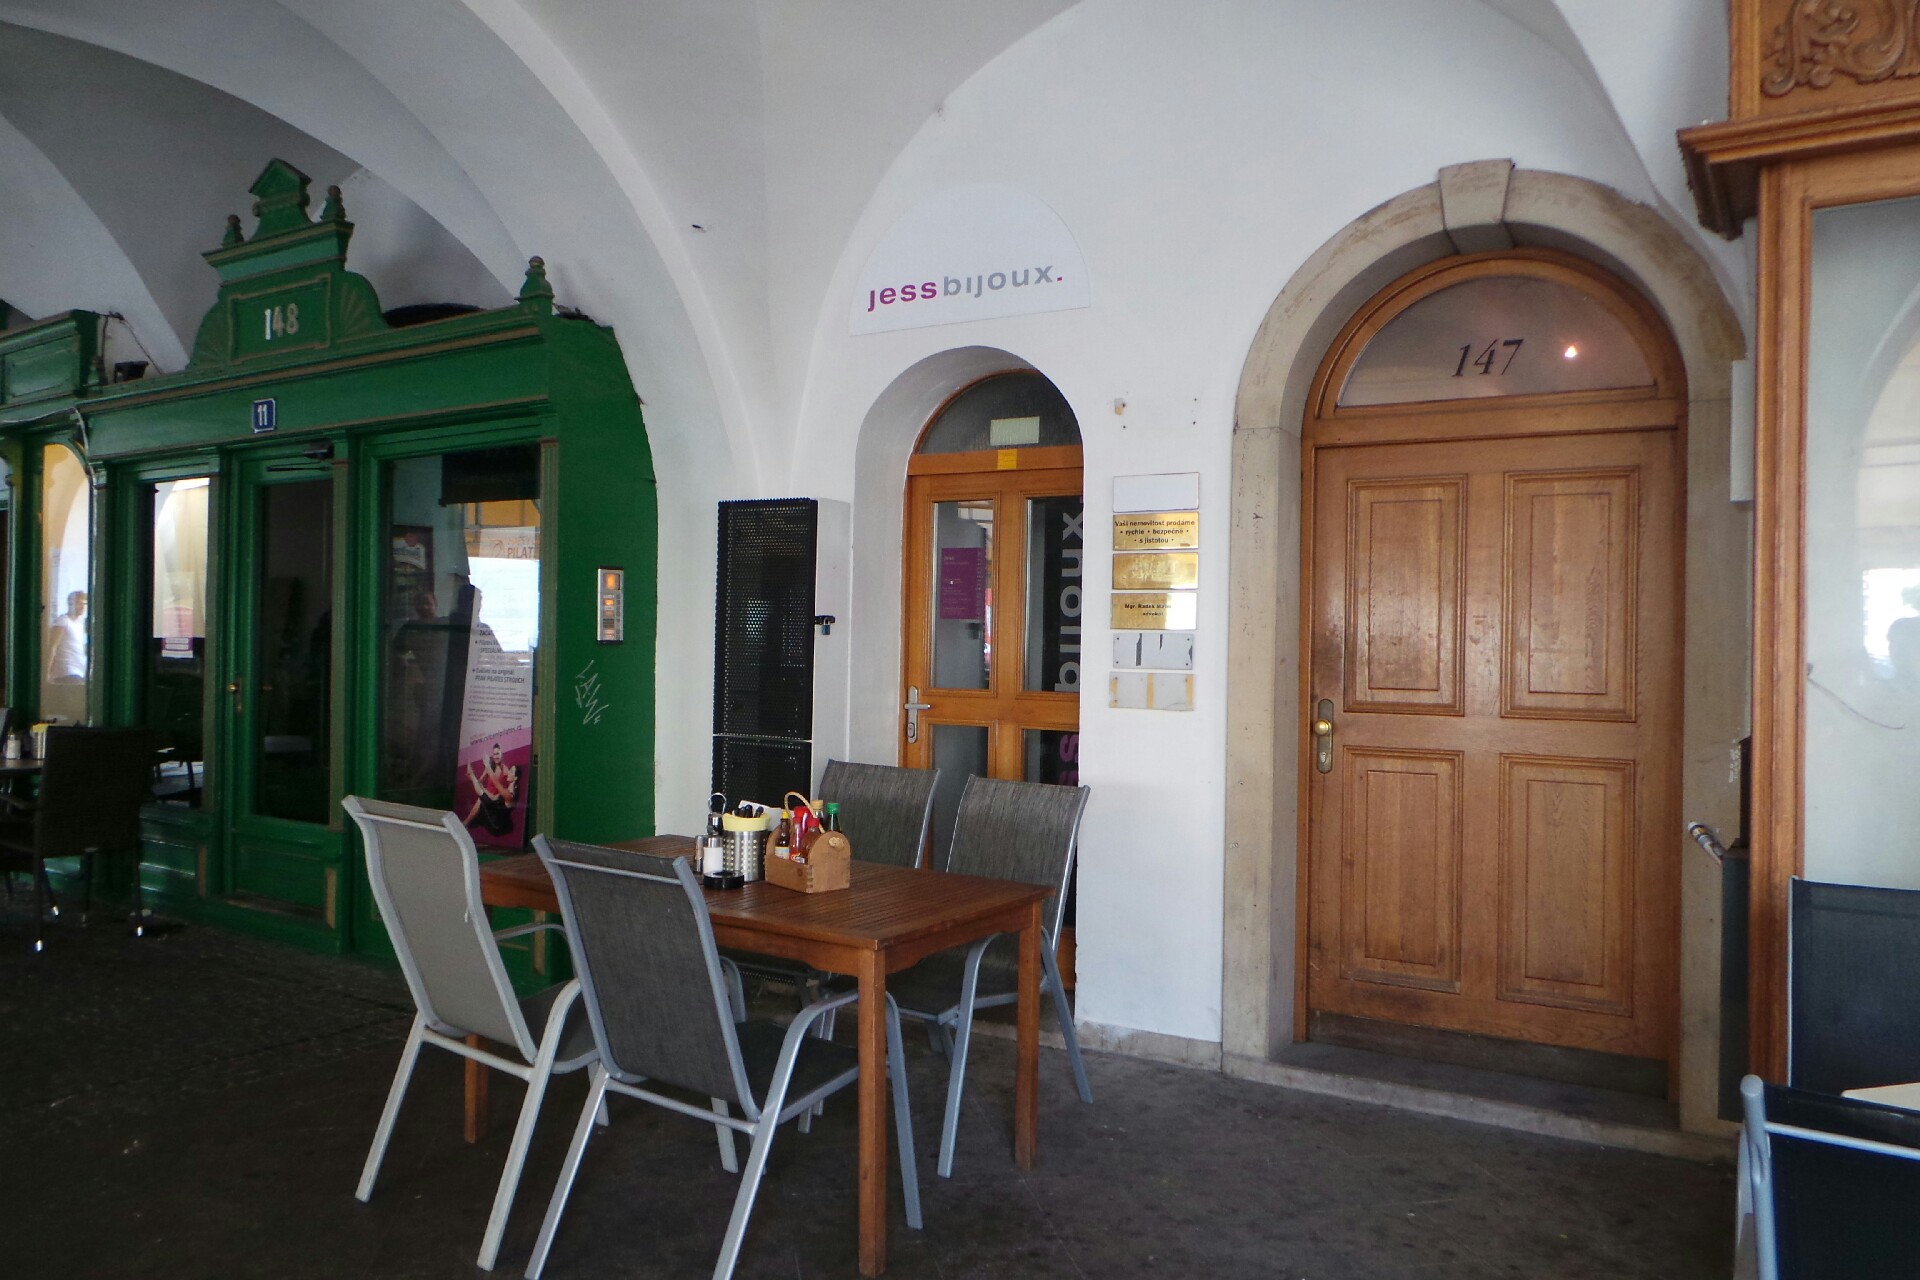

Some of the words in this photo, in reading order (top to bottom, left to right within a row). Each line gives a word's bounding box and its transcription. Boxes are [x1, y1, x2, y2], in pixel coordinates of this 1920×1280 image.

[264, 302, 299, 341] 148
[1451, 338, 1525, 378] 147
[257, 403, 268, 426] 11
